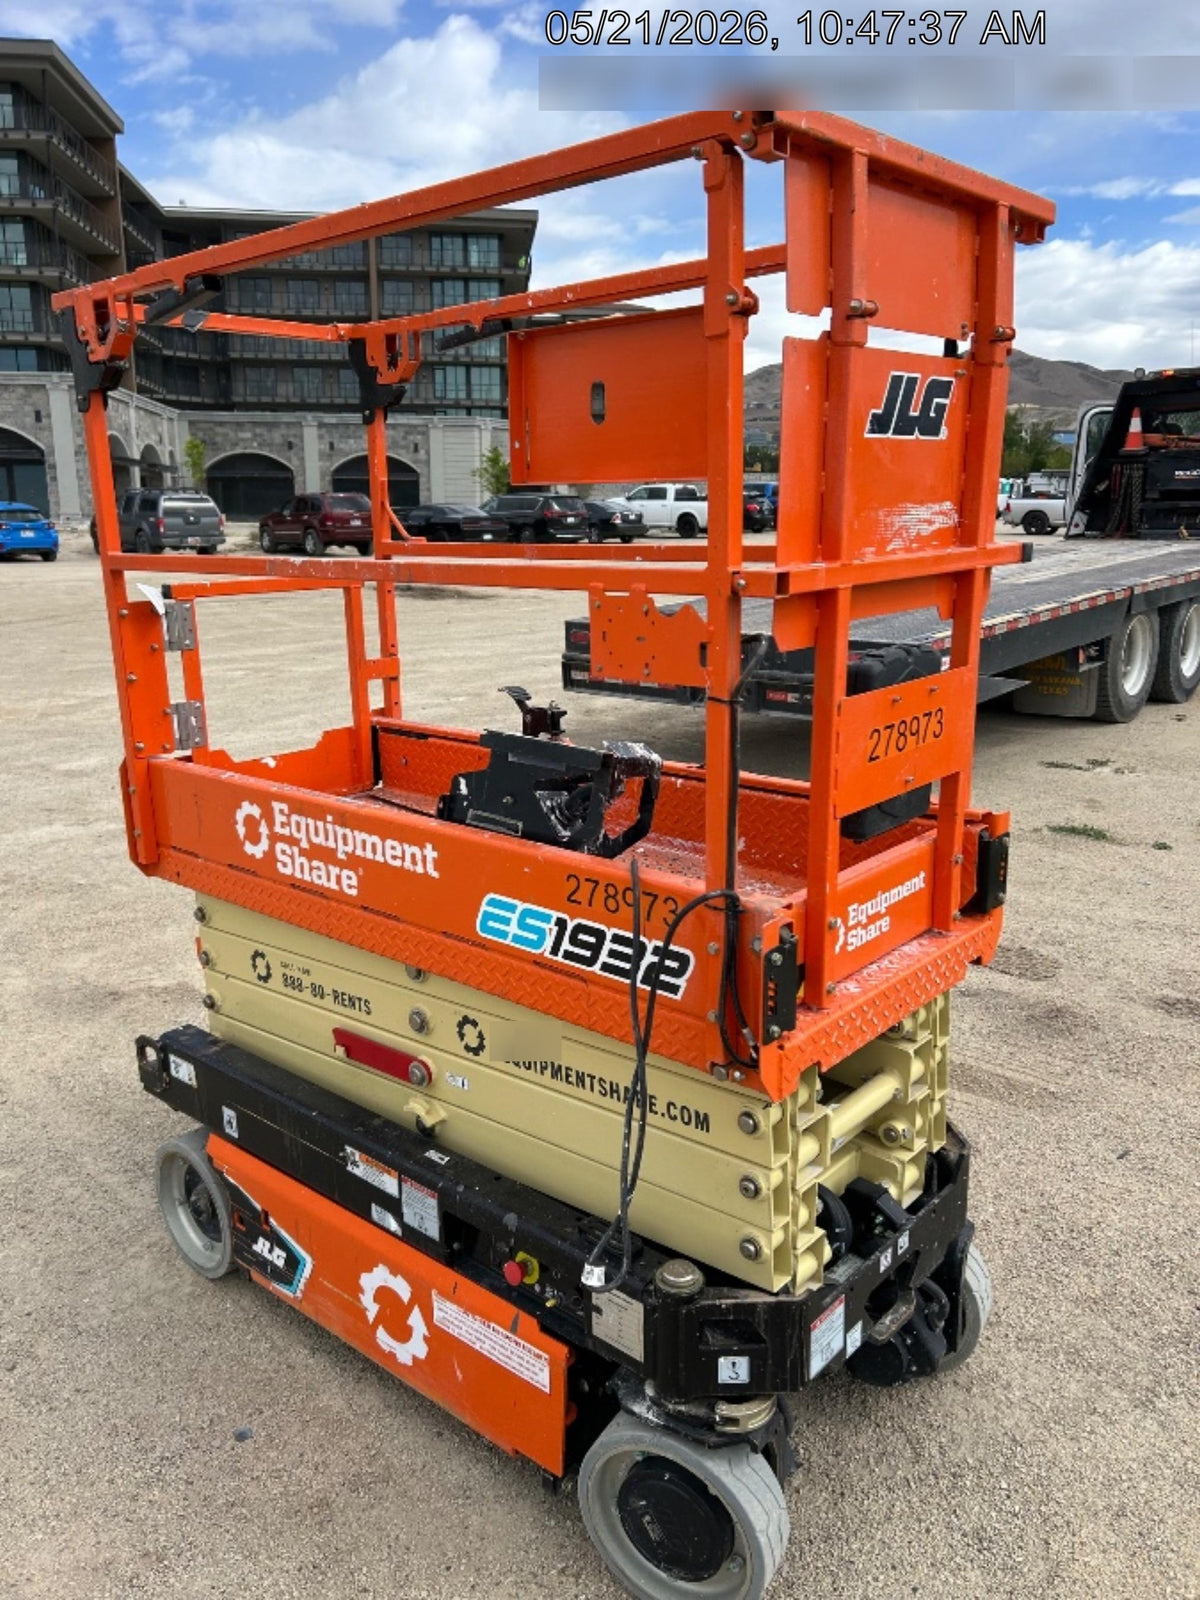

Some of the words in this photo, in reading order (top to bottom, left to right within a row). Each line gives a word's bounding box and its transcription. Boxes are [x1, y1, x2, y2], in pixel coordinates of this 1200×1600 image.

[864, 371, 955, 439] JLG
[868, 707, 943, 763] 278973
[271, 800, 440, 879] Equipment
[274, 841, 359, 896] Share
[847, 870, 926, 927] Equipment
[478, 894, 694, 998] ES1932
[846, 915, 890, 952] Share
[252, 1236, 287, 1269] JLG
